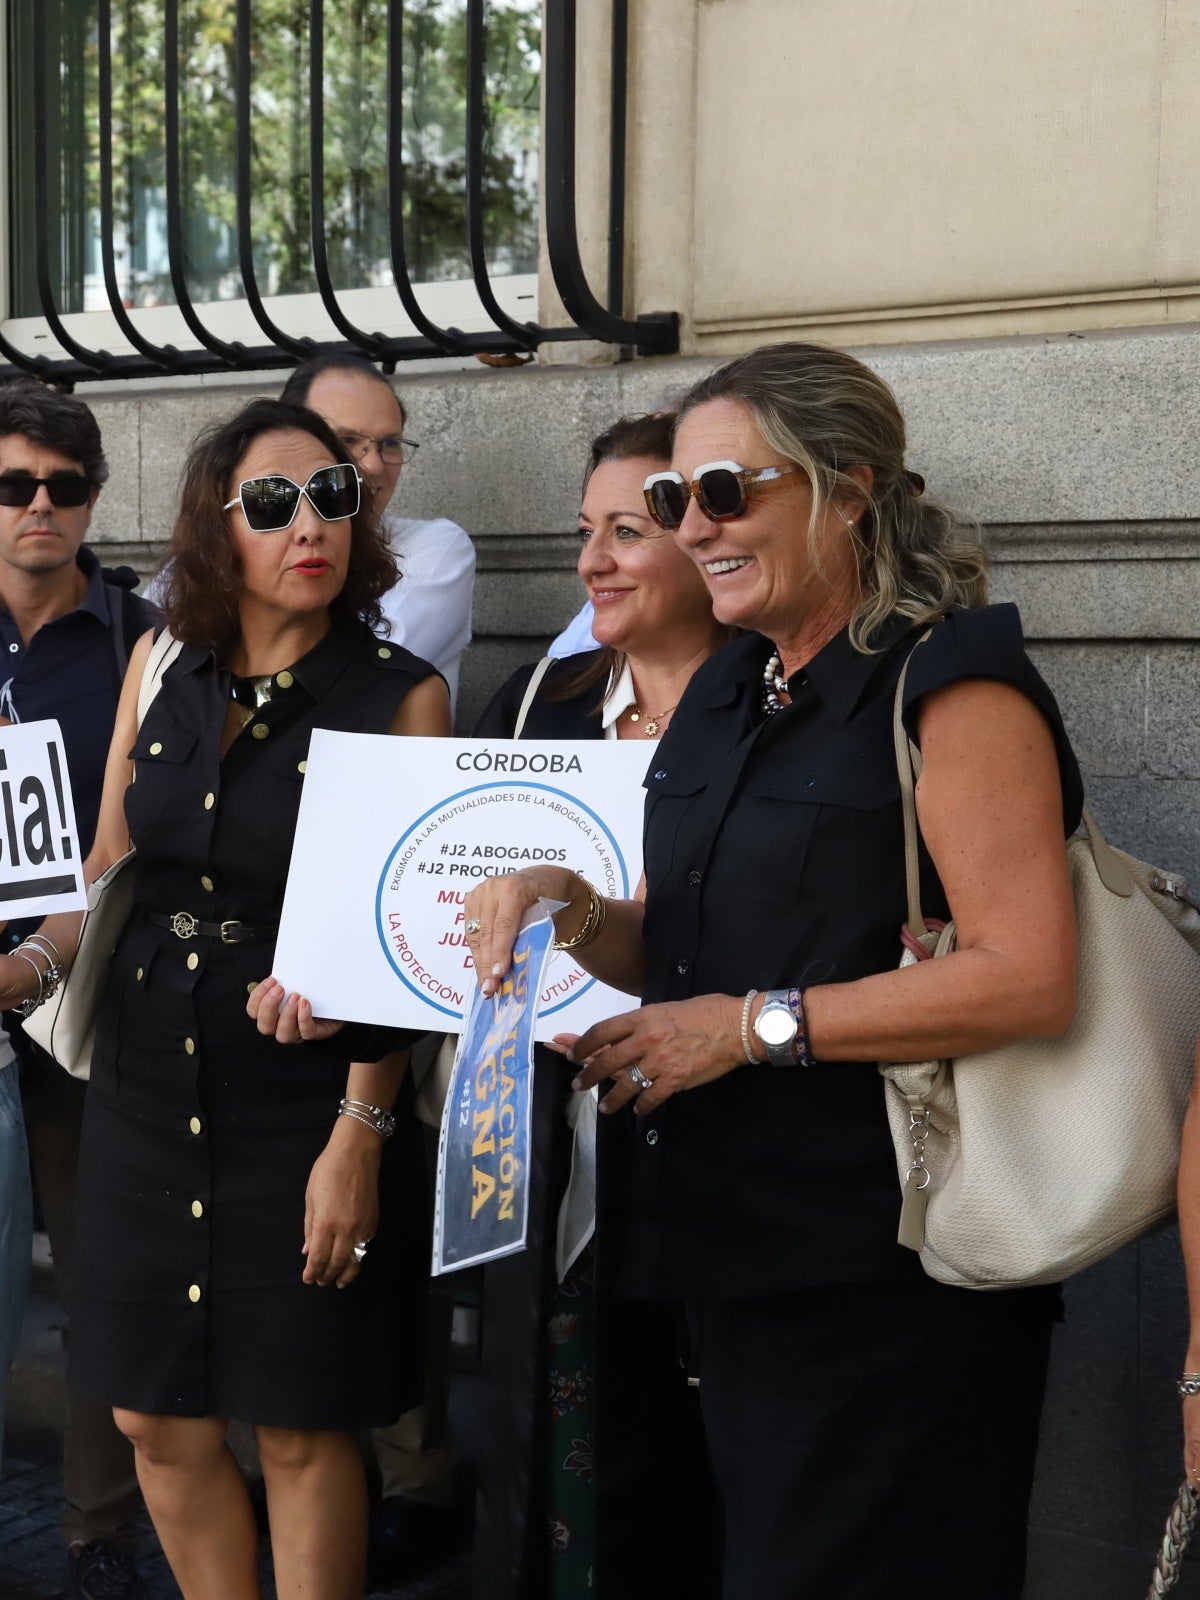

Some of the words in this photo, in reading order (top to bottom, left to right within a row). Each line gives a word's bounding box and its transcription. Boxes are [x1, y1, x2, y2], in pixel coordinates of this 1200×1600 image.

[456, 749, 583, 773] CÓRDOBA
[517, 793, 531, 803] DE
[533, 796, 545, 806] LA
[437, 793, 514, 824] MUTUALIDADES
[421, 821, 438, 838] LAS
[591, 834, 599, 842] Y
[415, 838, 423, 846] A
[594, 842, 606, 856] LA
[440, 843, 467, 857] #J2
[471, 845, 567, 861] ABOGADOS
[390, 845, 417, 891] EXIGIMOS
[418, 861, 445, 875] #J2
[602, 856, 616, 898] PROCUR
[388, 913, 401, 931] LA
[393, 934, 464, 1005] PROTECCIÓN
